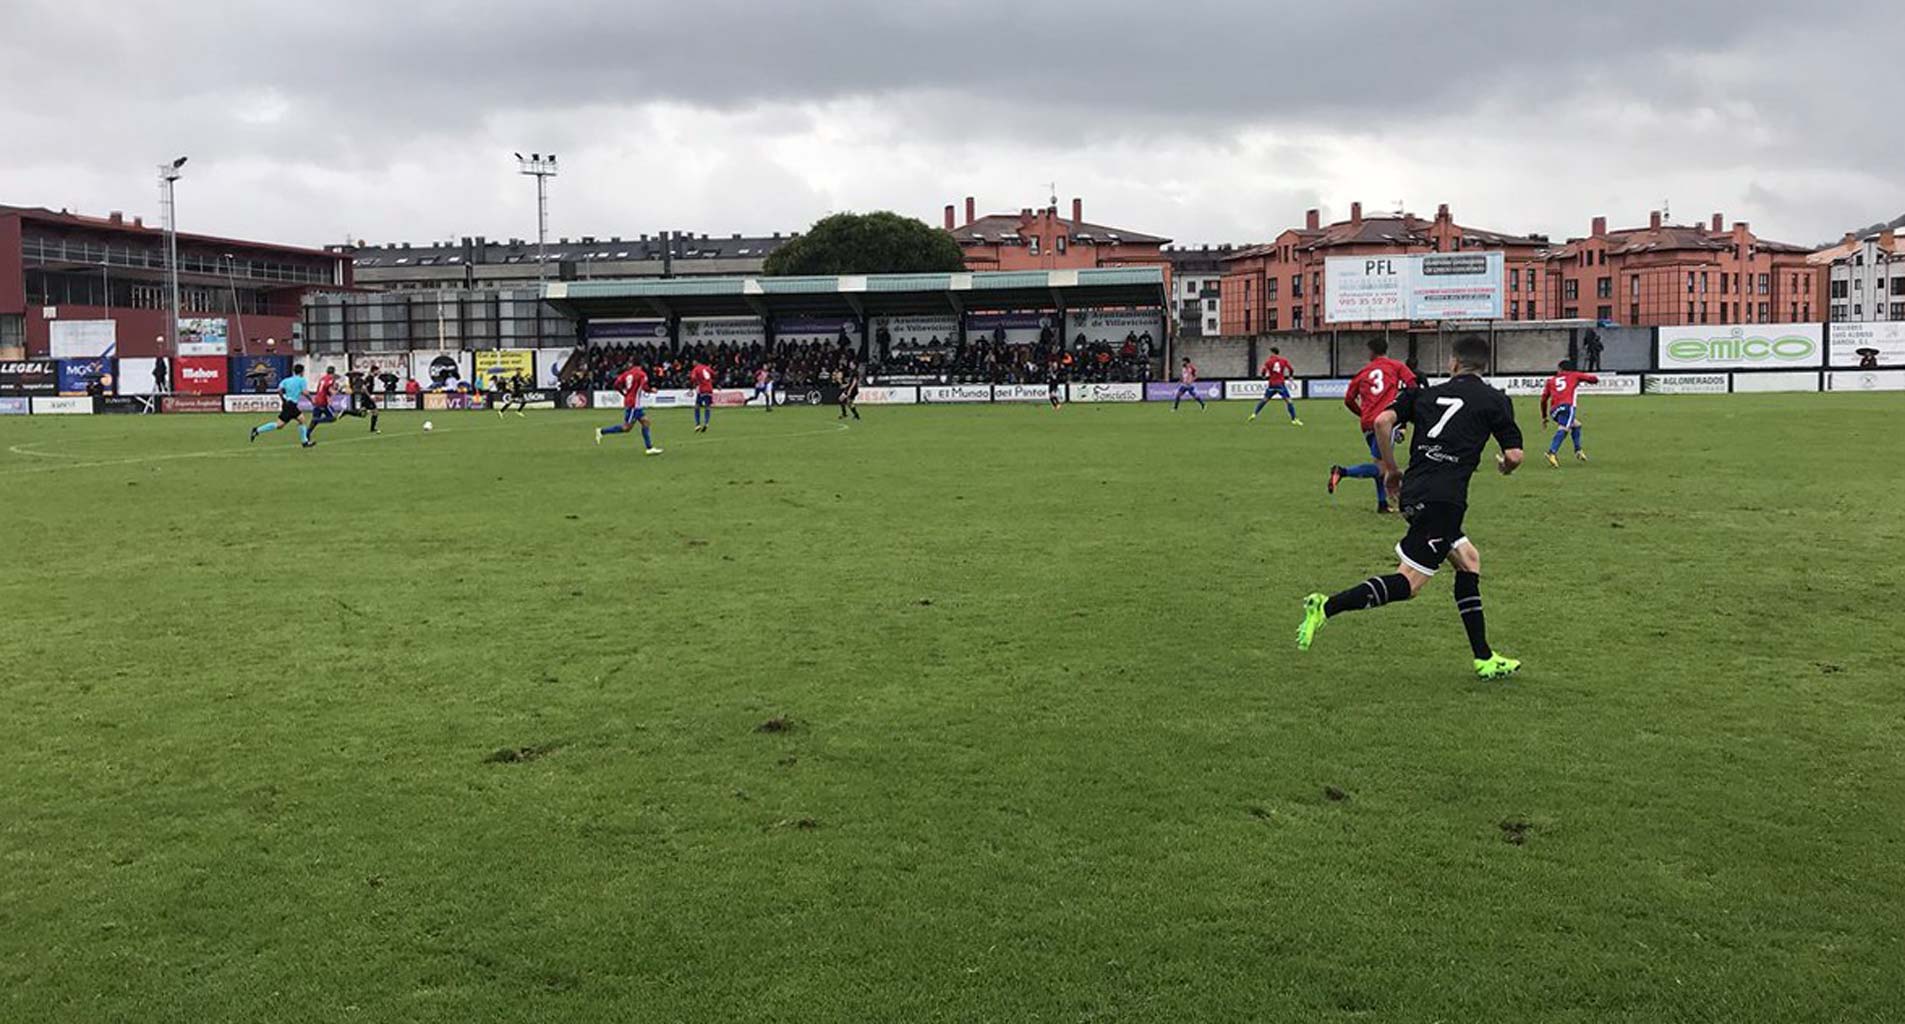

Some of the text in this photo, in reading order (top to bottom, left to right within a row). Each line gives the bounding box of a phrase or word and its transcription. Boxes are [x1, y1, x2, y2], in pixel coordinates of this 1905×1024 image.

[1366, 260, 1397, 275] PFL
[1667, 337, 1816, 361] emico
[1272, 361, 1281, 373] 4
[1368, 369, 1384, 395] 3
[1555, 376, 1567, 391] 5
[1663, 376, 1724, 385] AGLOMERADOS
[938, 387, 989, 398] El Mundo
[1015, 386, 1047, 398] Pintor
[231, 400, 280, 409] NACHO
[1427, 397, 1464, 438] 7
